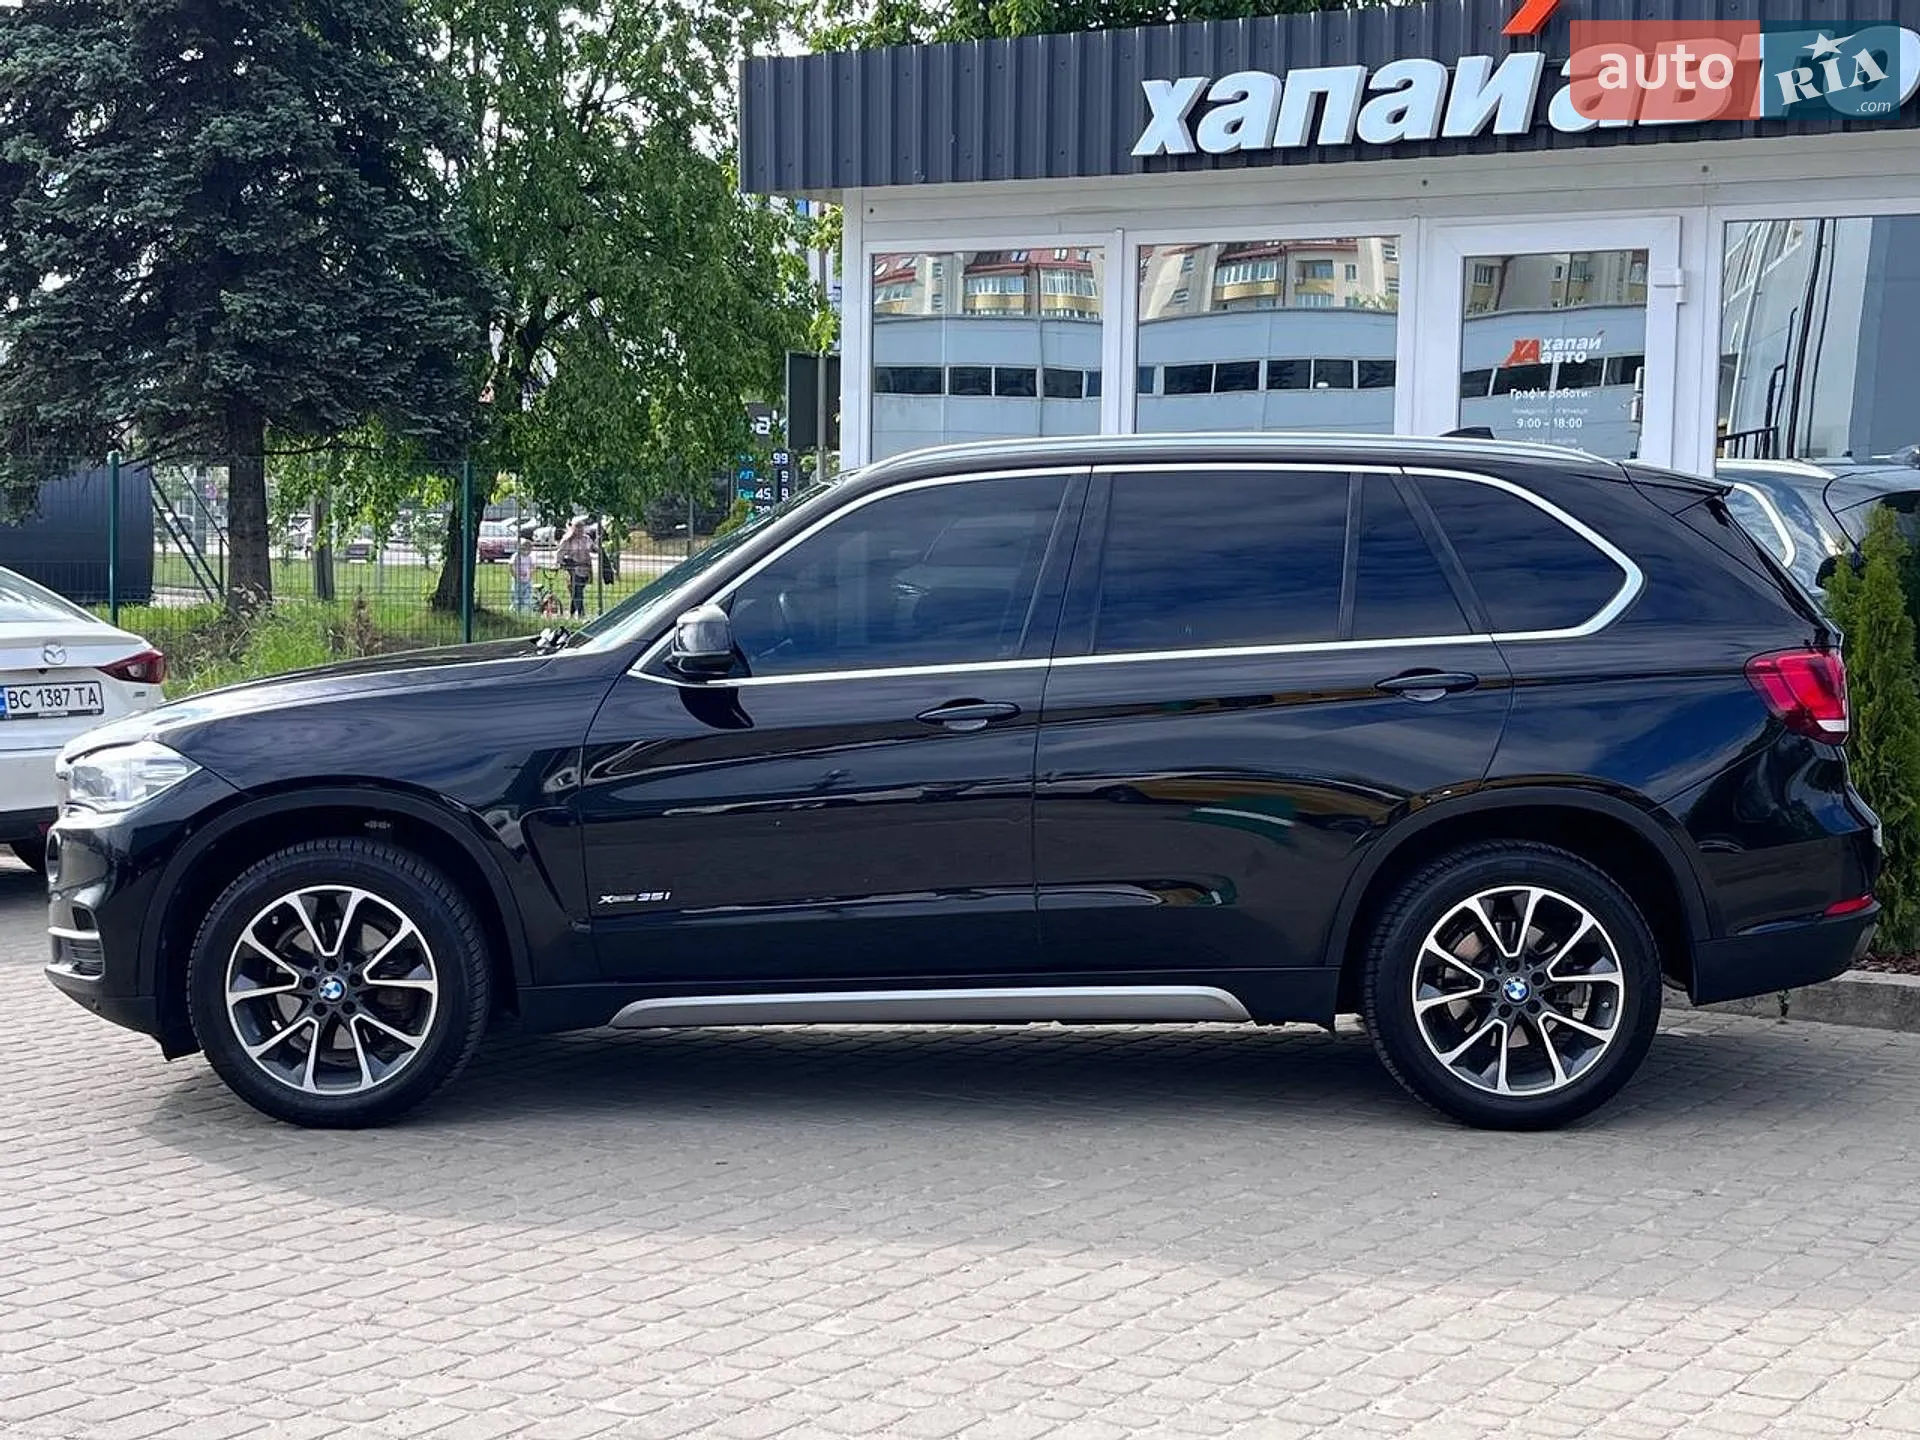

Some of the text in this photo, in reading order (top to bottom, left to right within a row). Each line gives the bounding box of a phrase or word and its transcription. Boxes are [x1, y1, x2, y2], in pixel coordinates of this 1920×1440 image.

[1543, 331, 1604, 350] хапай
[1541, 351, 1587, 363] авто
[1516, 418, 1541, 428] 9:00
[1554, 418, 1582, 428] 18:00
[8, 687, 98, 709] BC 1387 TA
